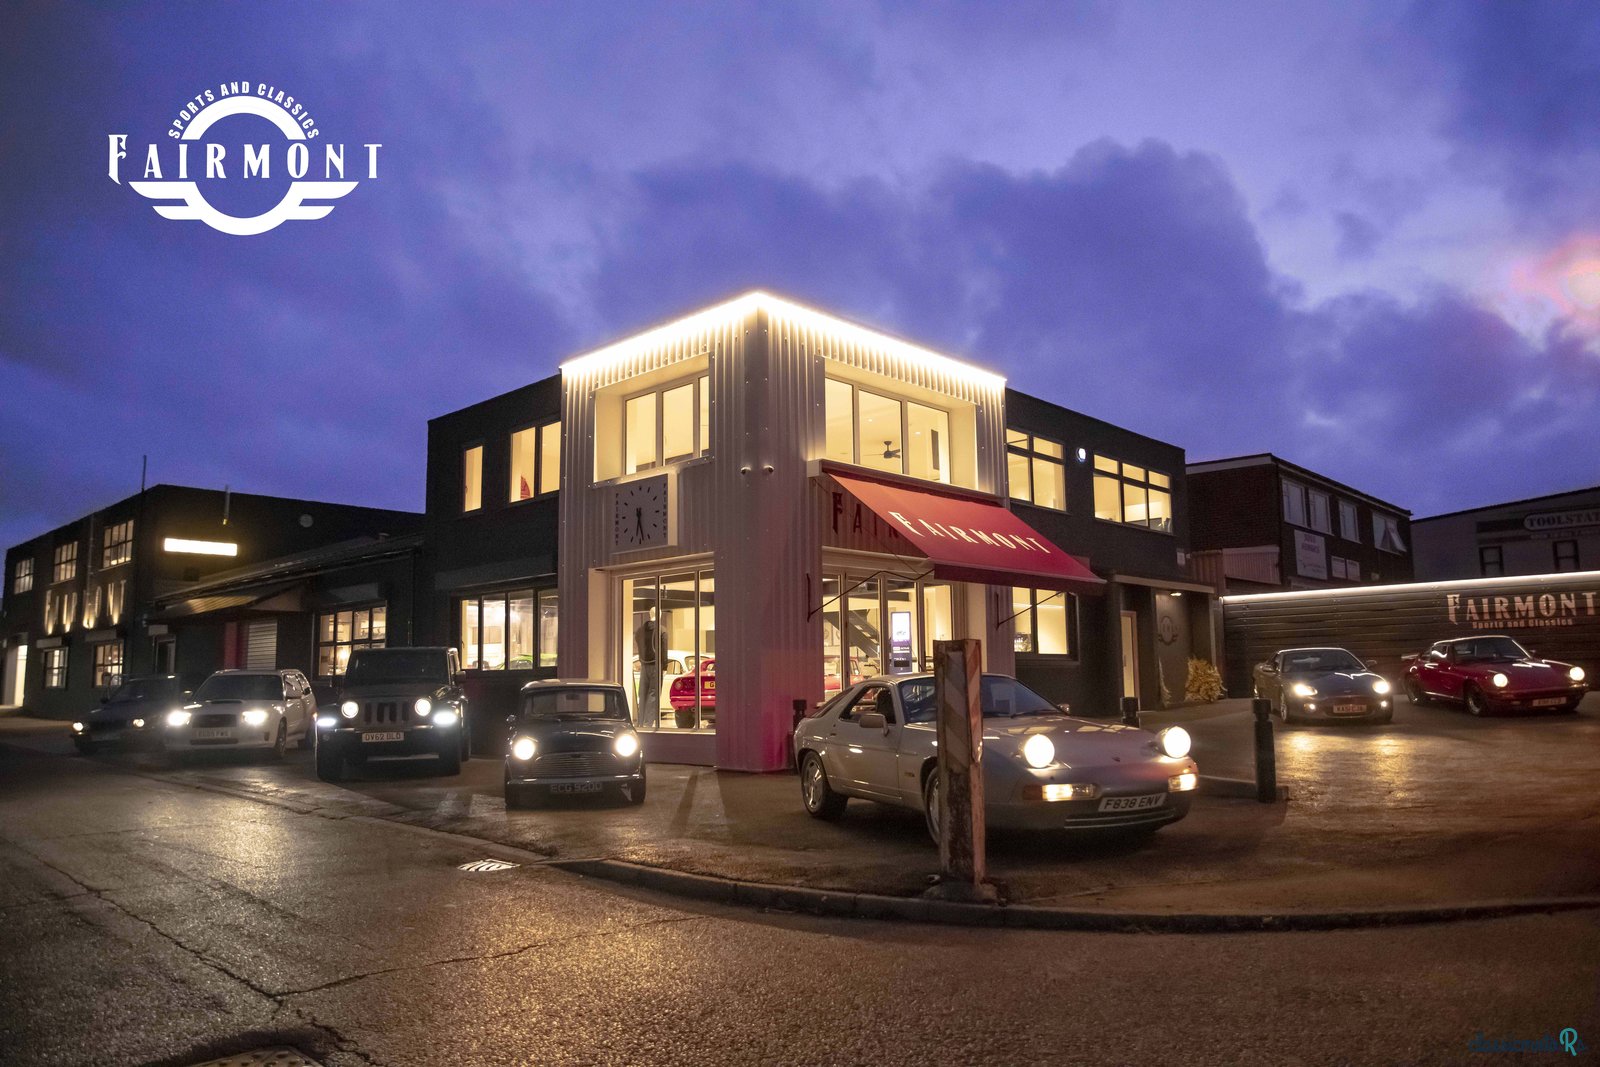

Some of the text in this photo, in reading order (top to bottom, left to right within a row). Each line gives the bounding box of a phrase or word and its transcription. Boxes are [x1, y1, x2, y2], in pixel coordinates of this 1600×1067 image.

[888, 511, 1051, 553] FAIRMONT
[1446, 592, 1597, 625] FAIRMONT
[1472, 618, 1573, 629] Sports and Classics
[1103, 795, 1161, 810] F838 ENV
